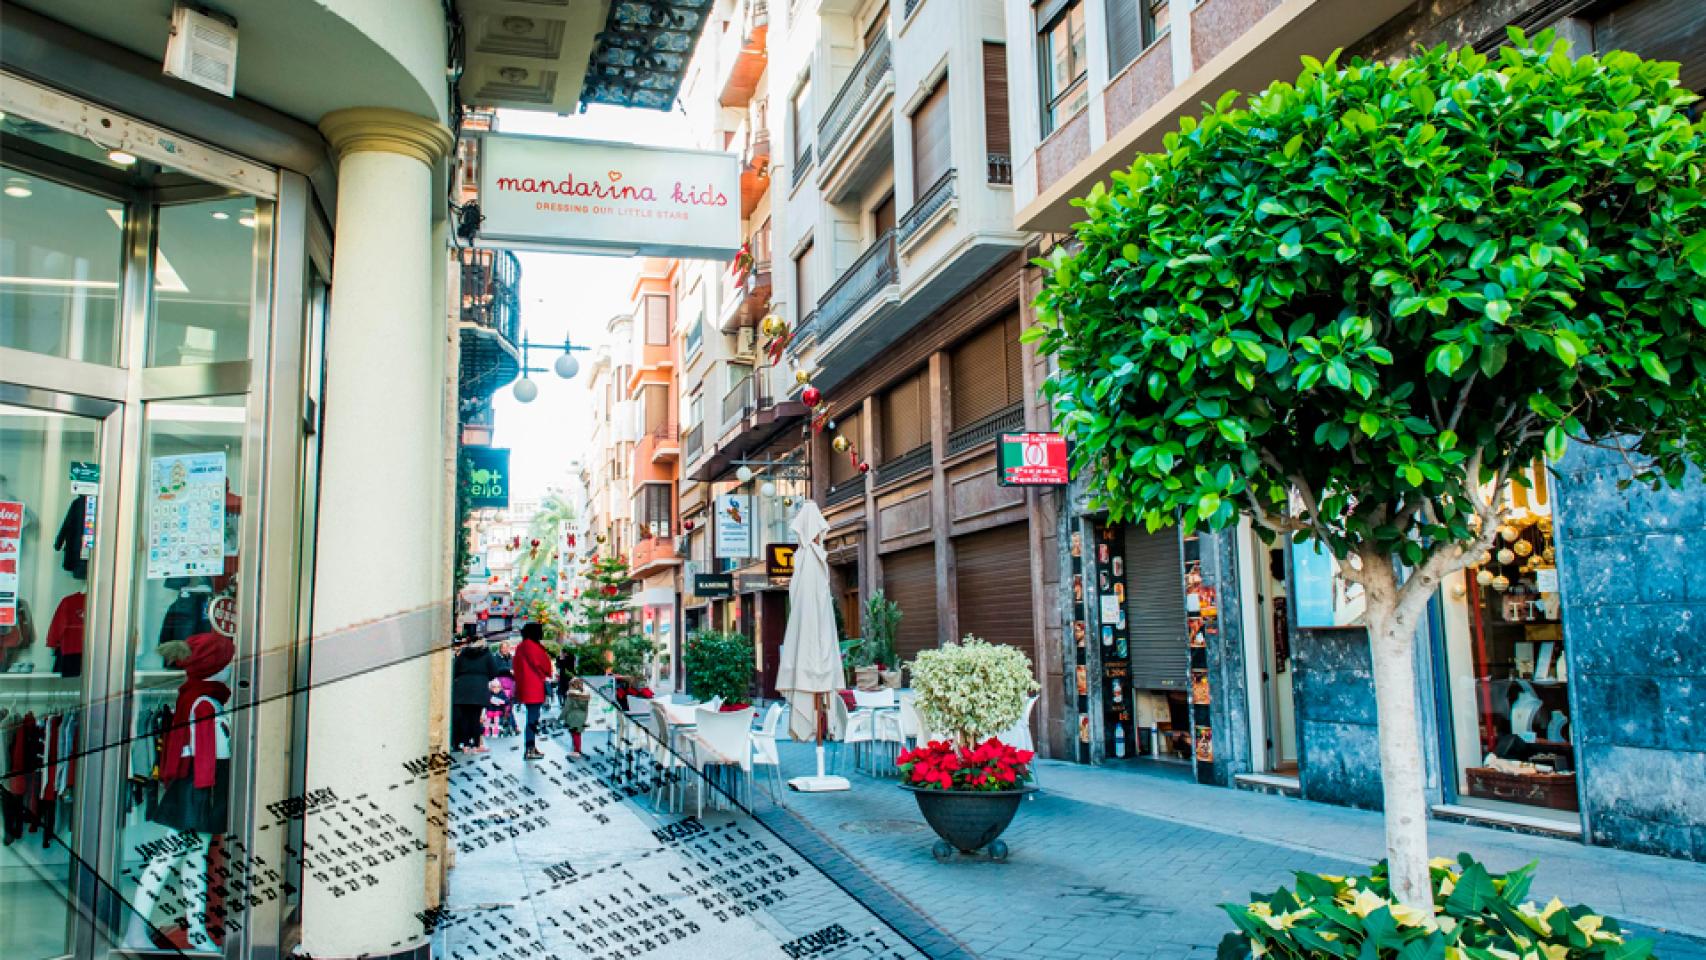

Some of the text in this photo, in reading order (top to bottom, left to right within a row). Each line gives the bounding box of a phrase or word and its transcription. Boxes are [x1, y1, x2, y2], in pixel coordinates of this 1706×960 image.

[496, 171, 728, 207] mandarina kids
[535, 201, 689, 220] DRESSING OUR LITTLE STARS
